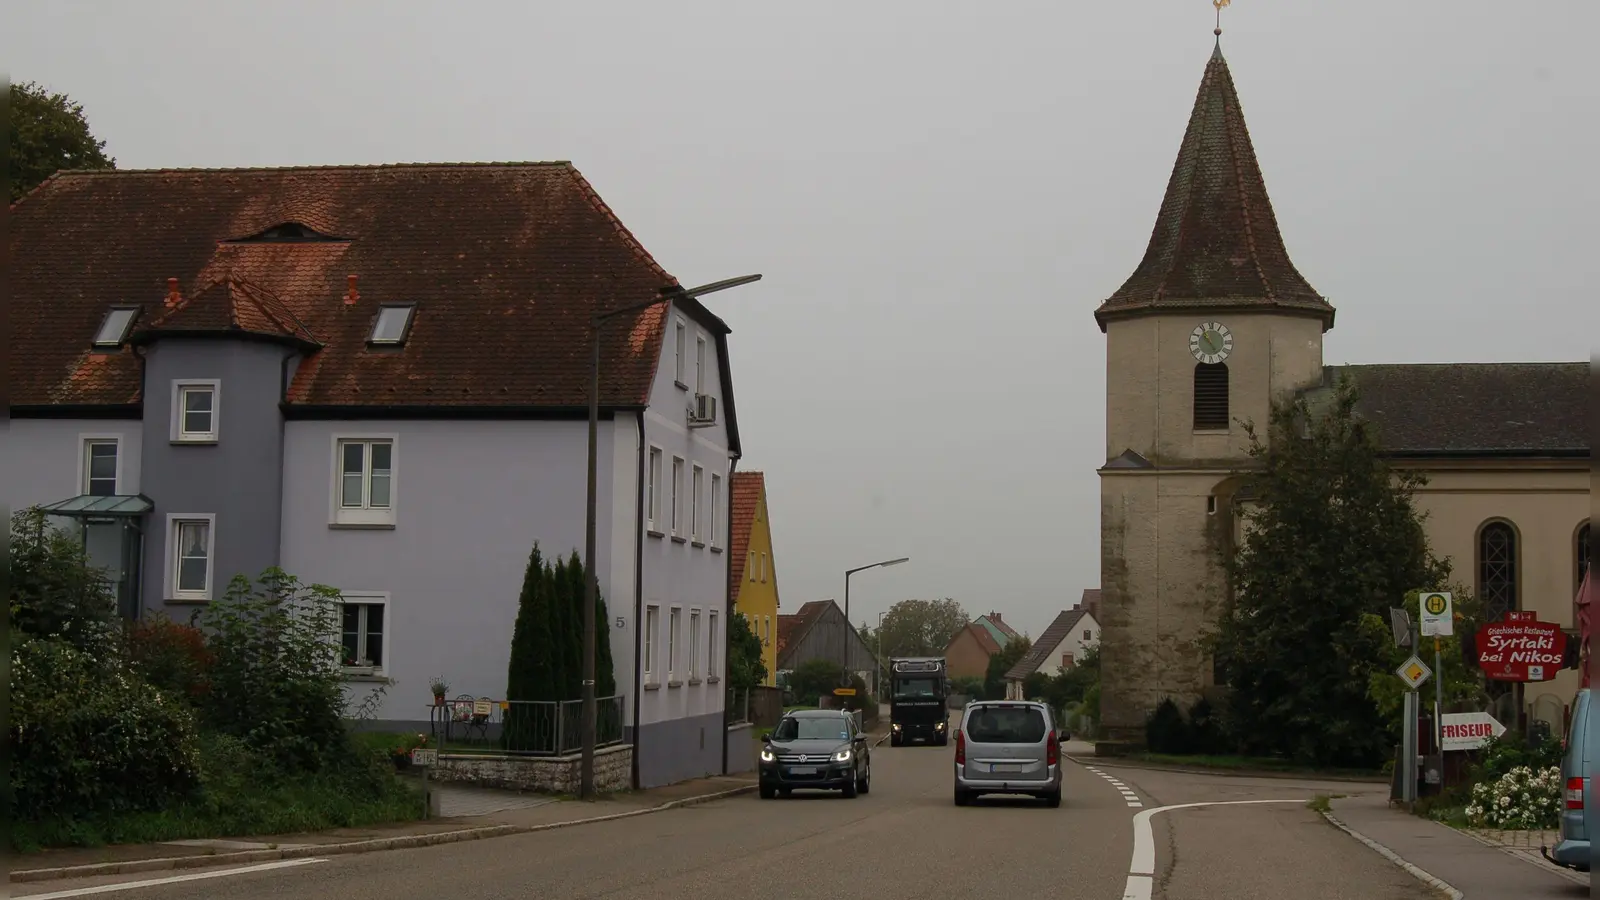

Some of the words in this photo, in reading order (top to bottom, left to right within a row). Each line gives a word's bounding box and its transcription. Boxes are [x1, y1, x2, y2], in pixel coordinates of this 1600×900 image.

[1431, 597, 1441, 611] H
[615, 616, 625, 628] 5
[1487, 625, 1523, 635] Griechisches
[1524, 626, 1555, 636] Restaurant
[1487, 635, 1554, 651] Syrtaki
[1479, 651, 1504, 662] bei
[1509, 650, 1563, 664] Nikos
[1441, 723, 1493, 738] FRISEUR
